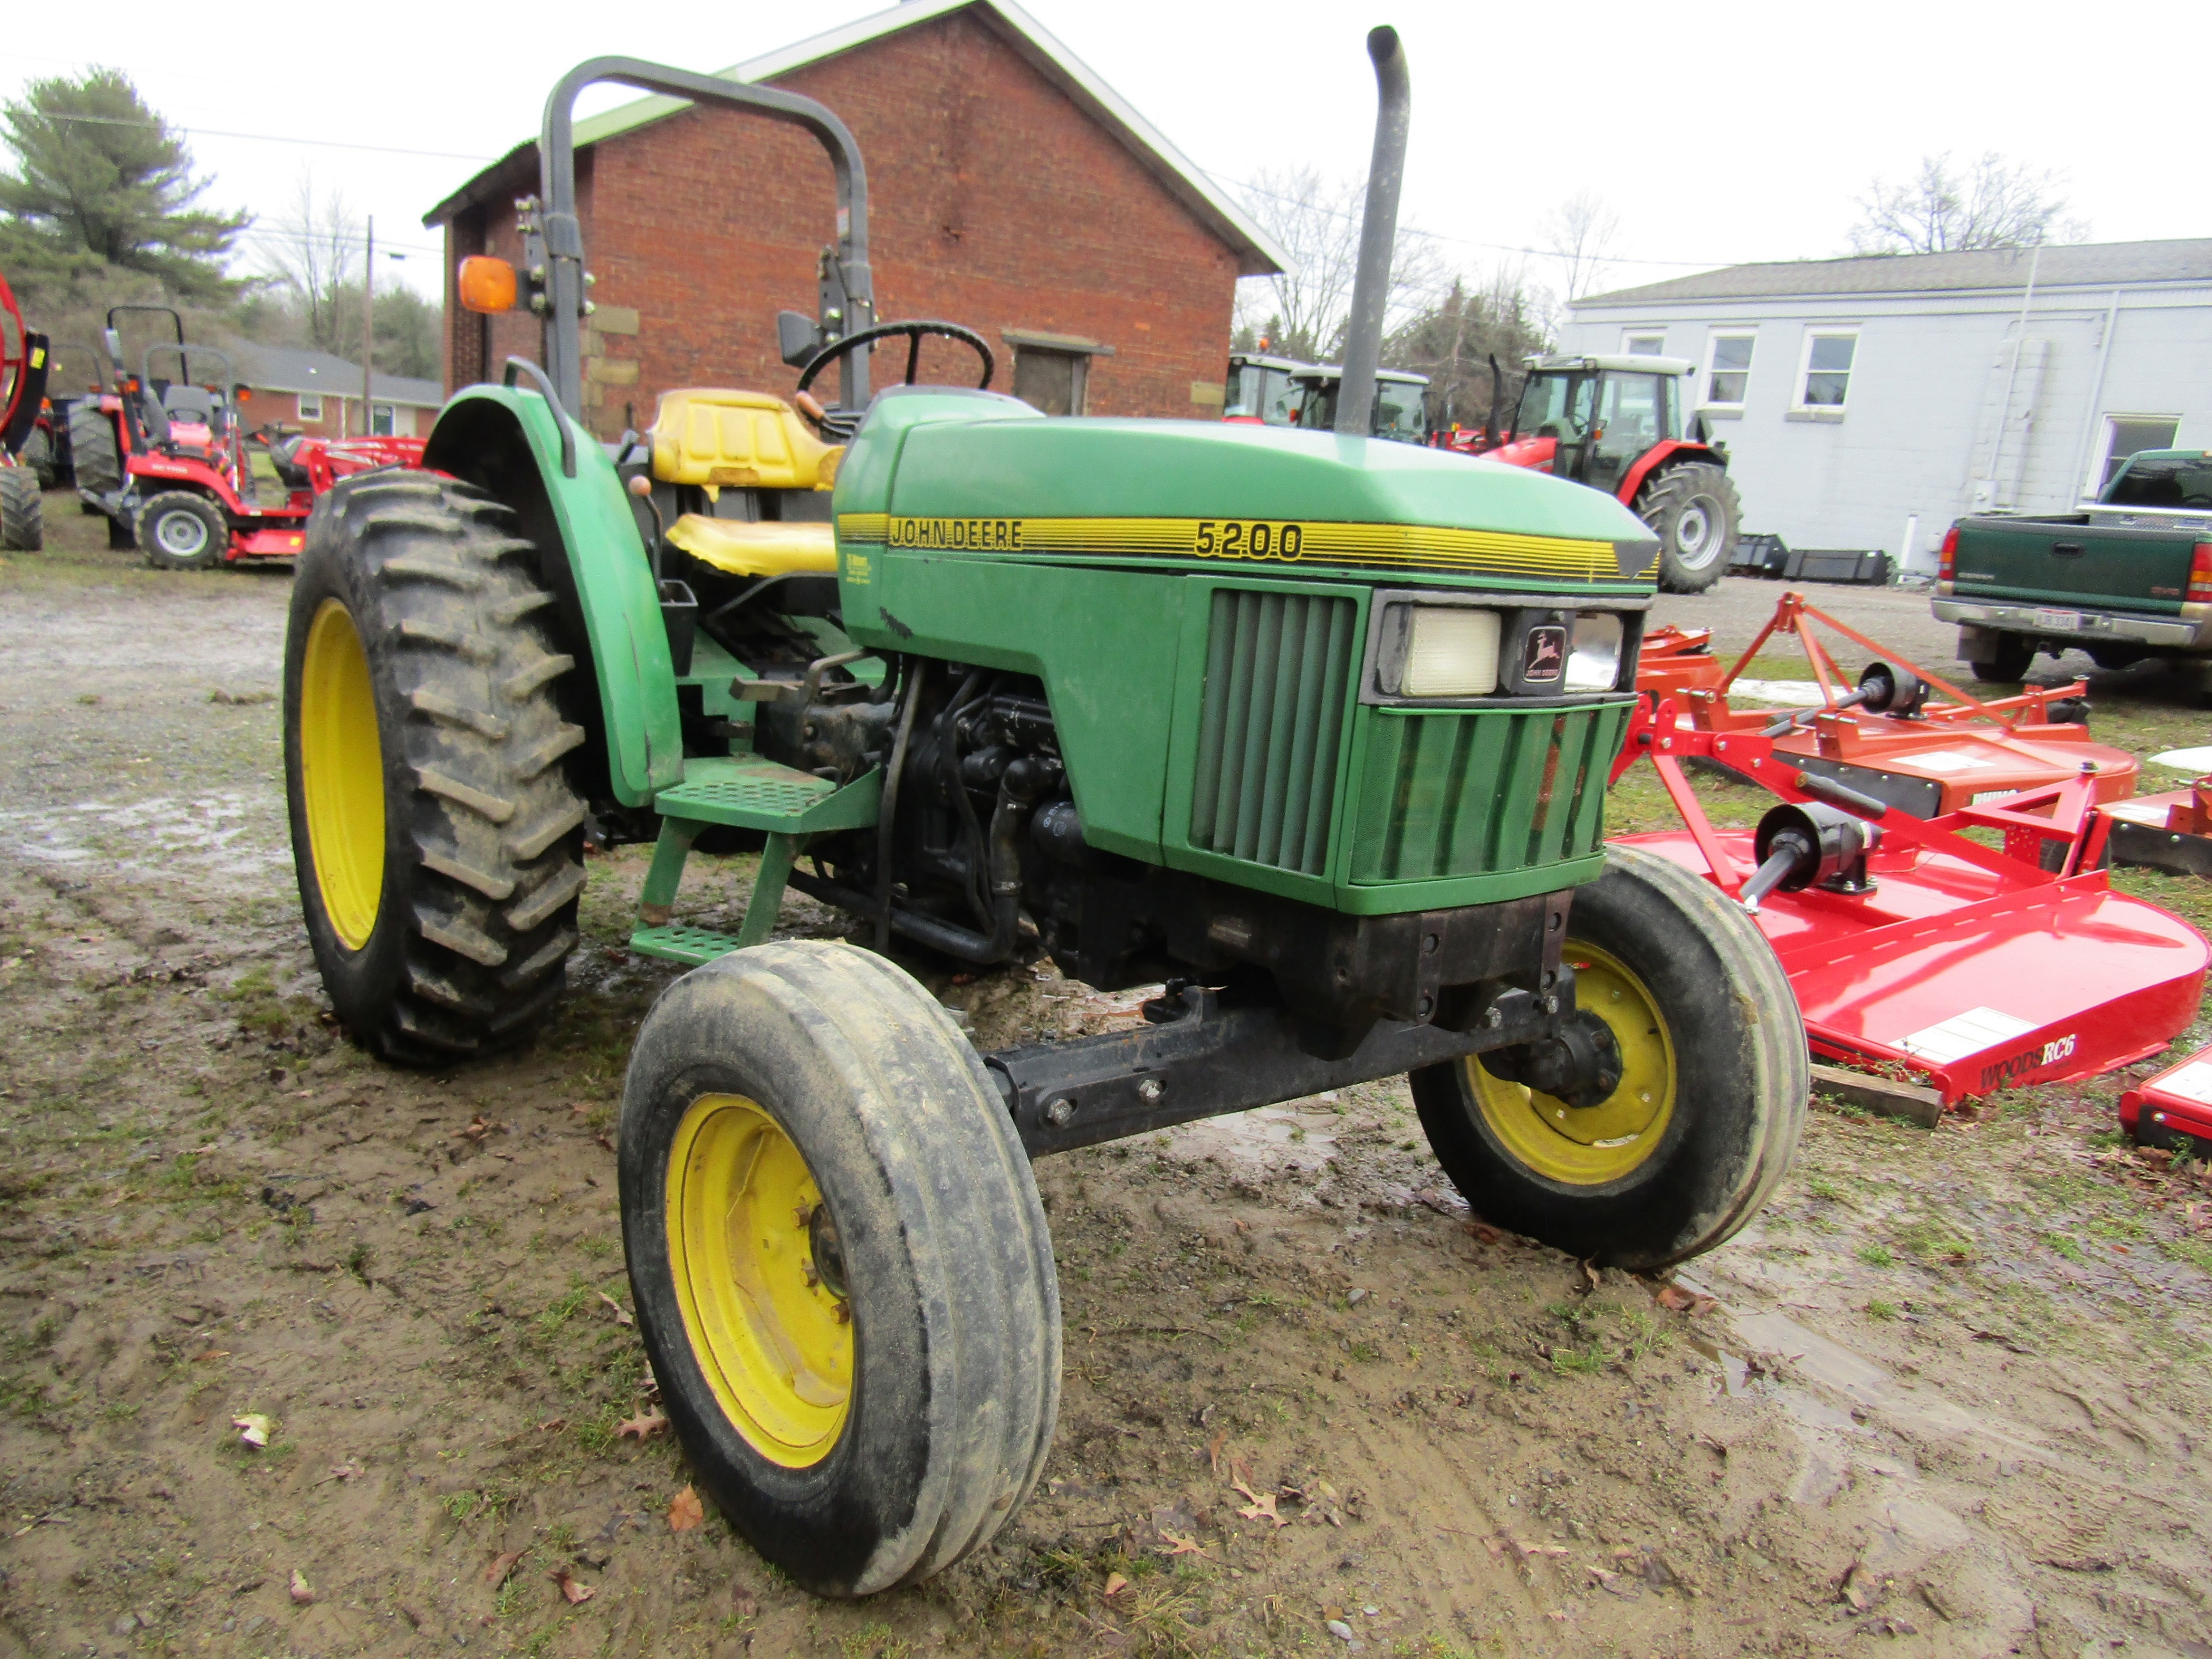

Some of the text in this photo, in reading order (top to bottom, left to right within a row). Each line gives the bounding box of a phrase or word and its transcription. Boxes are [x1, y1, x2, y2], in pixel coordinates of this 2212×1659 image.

[891, 520, 1023, 549] JOHN DEERE
[1195, 522, 1302, 559] 5200
[1542, 669, 1559, 677] DEERE
[1981, 1034, 2076, 1089] WOODS RC6
